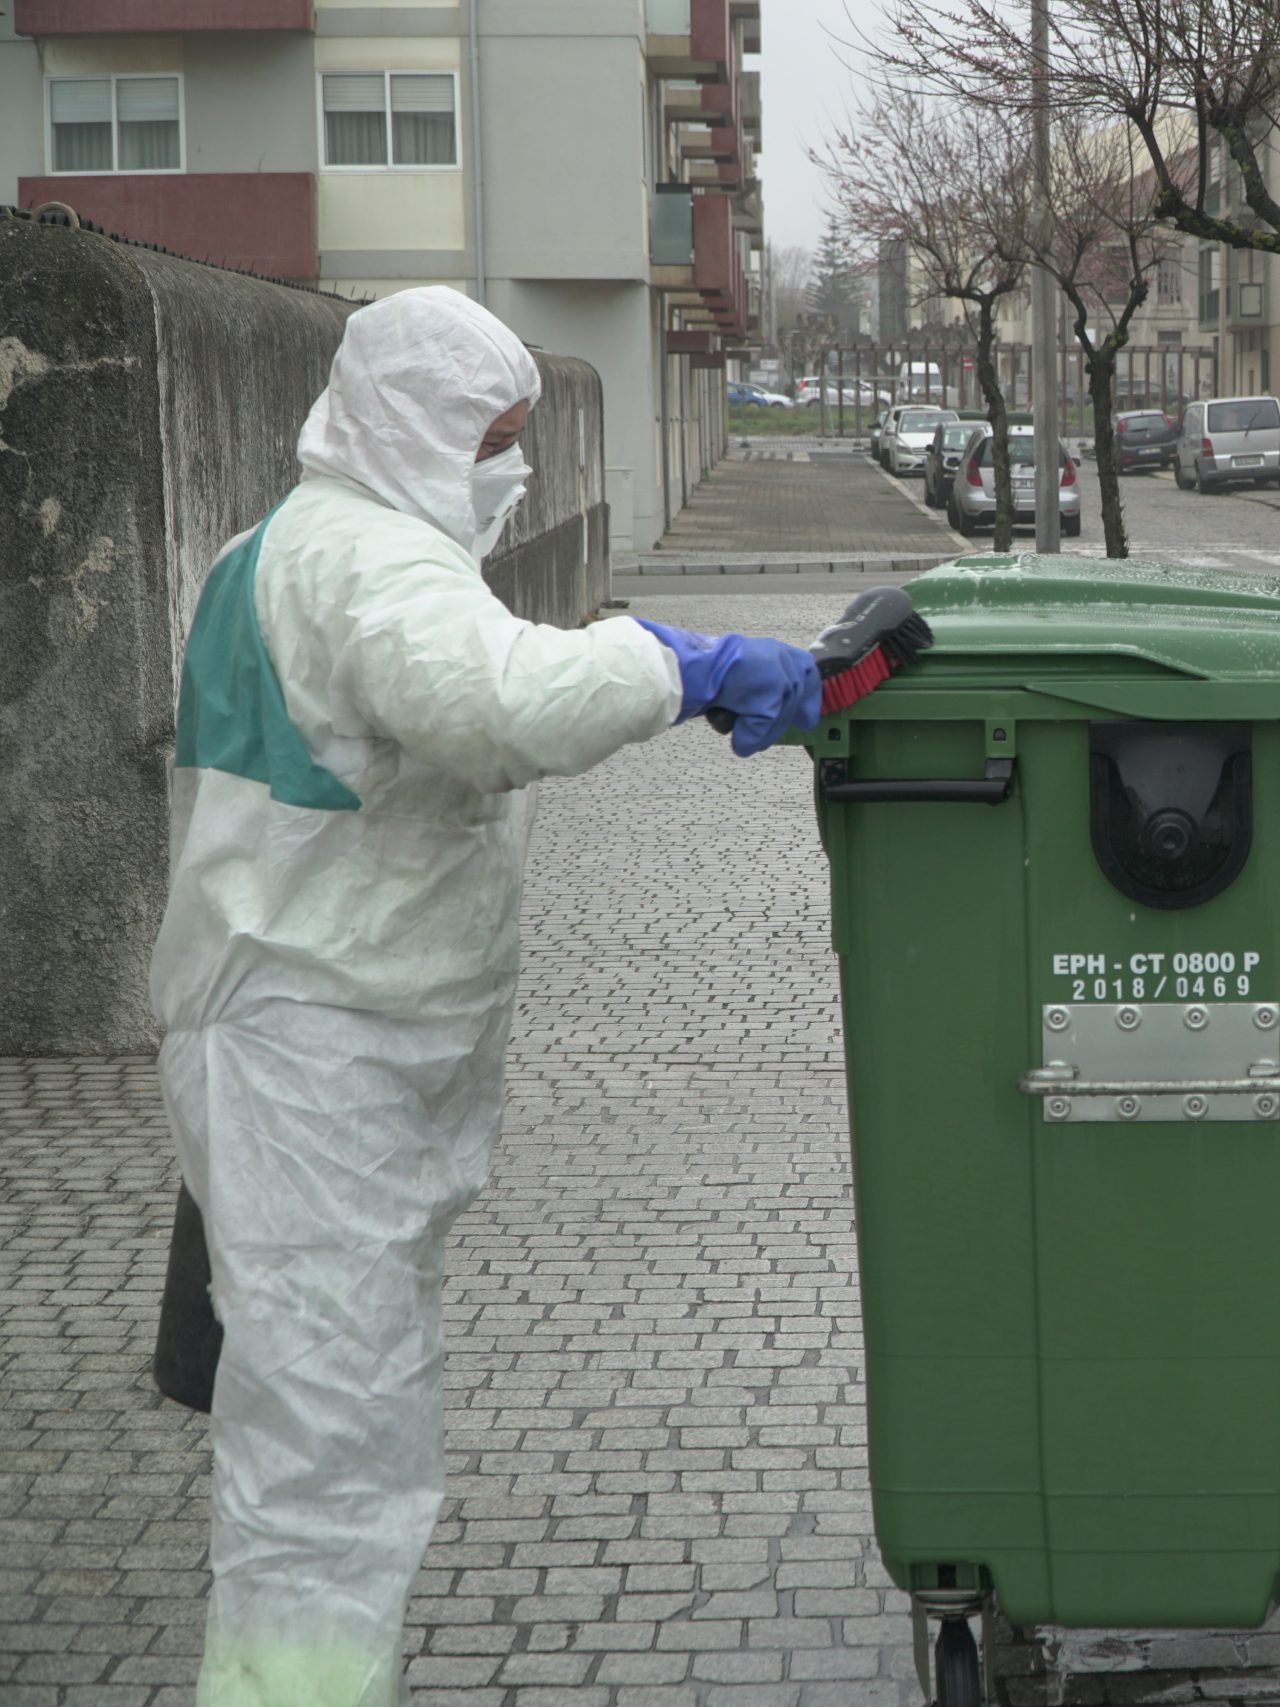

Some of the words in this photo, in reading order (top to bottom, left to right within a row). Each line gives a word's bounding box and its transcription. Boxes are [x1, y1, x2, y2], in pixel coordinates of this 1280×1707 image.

[1053, 954, 1105, 975] EPH
[1130, 953, 1165, 974] CT
[1173, 952, 1235, 974] 0800
[1244, 952, 1260, 972] P
[1072, 975, 1250, 1000] 2018/0469
